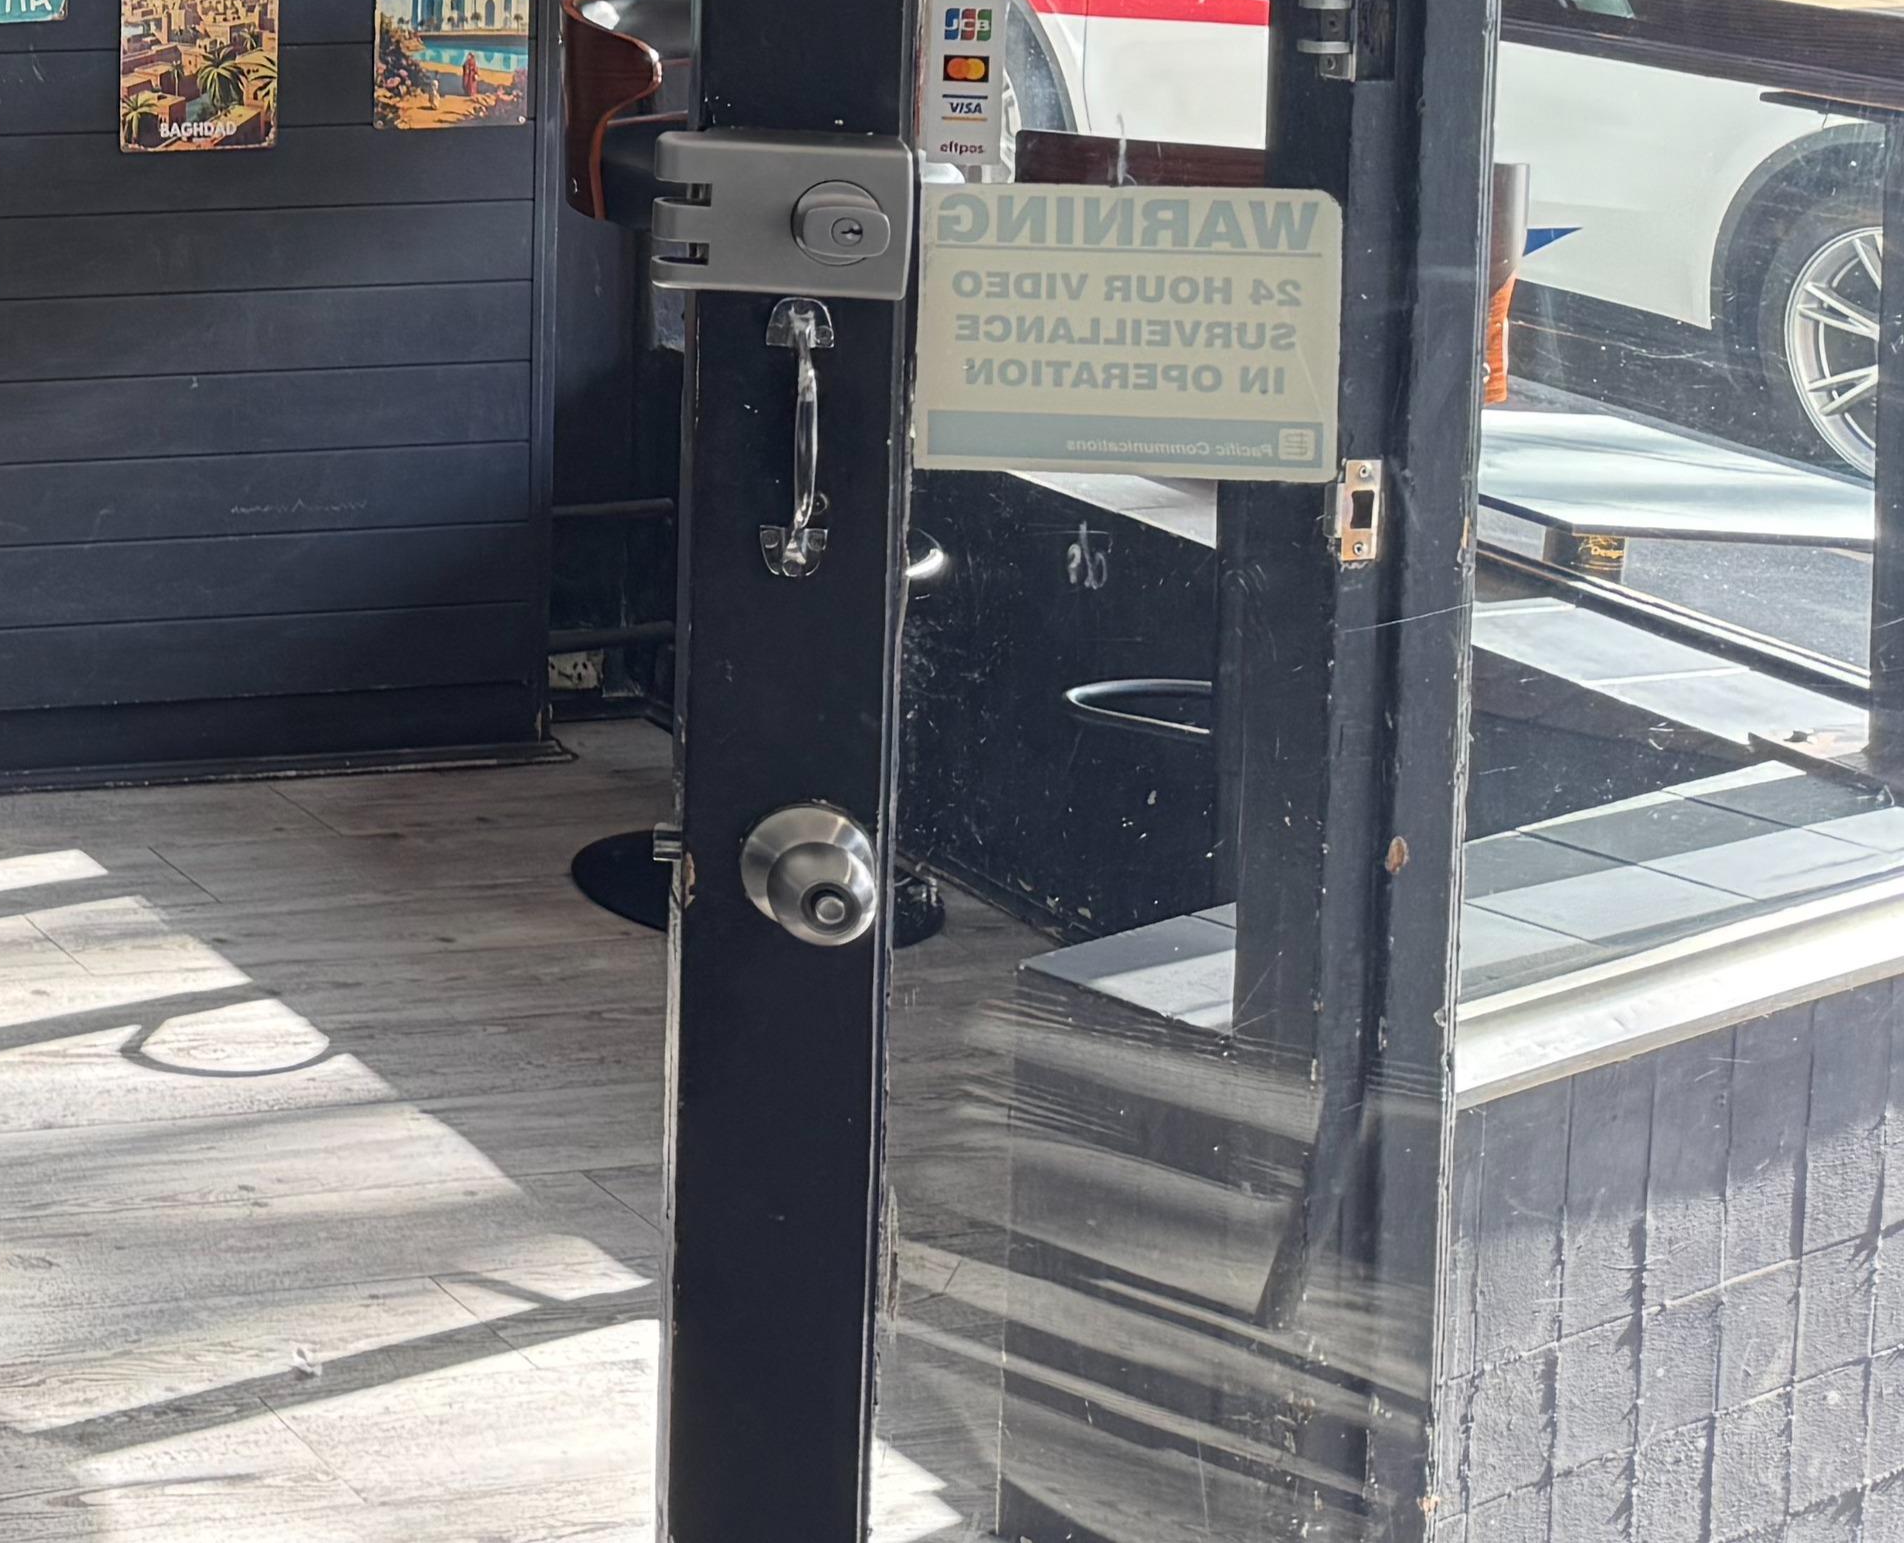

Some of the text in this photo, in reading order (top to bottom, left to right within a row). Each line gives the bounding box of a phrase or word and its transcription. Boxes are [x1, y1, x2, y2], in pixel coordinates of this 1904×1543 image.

[949, 102, 983, 114] VISA
[160, 121, 237, 138] BAGHDAD
[940, 141, 985, 155] eftpos
